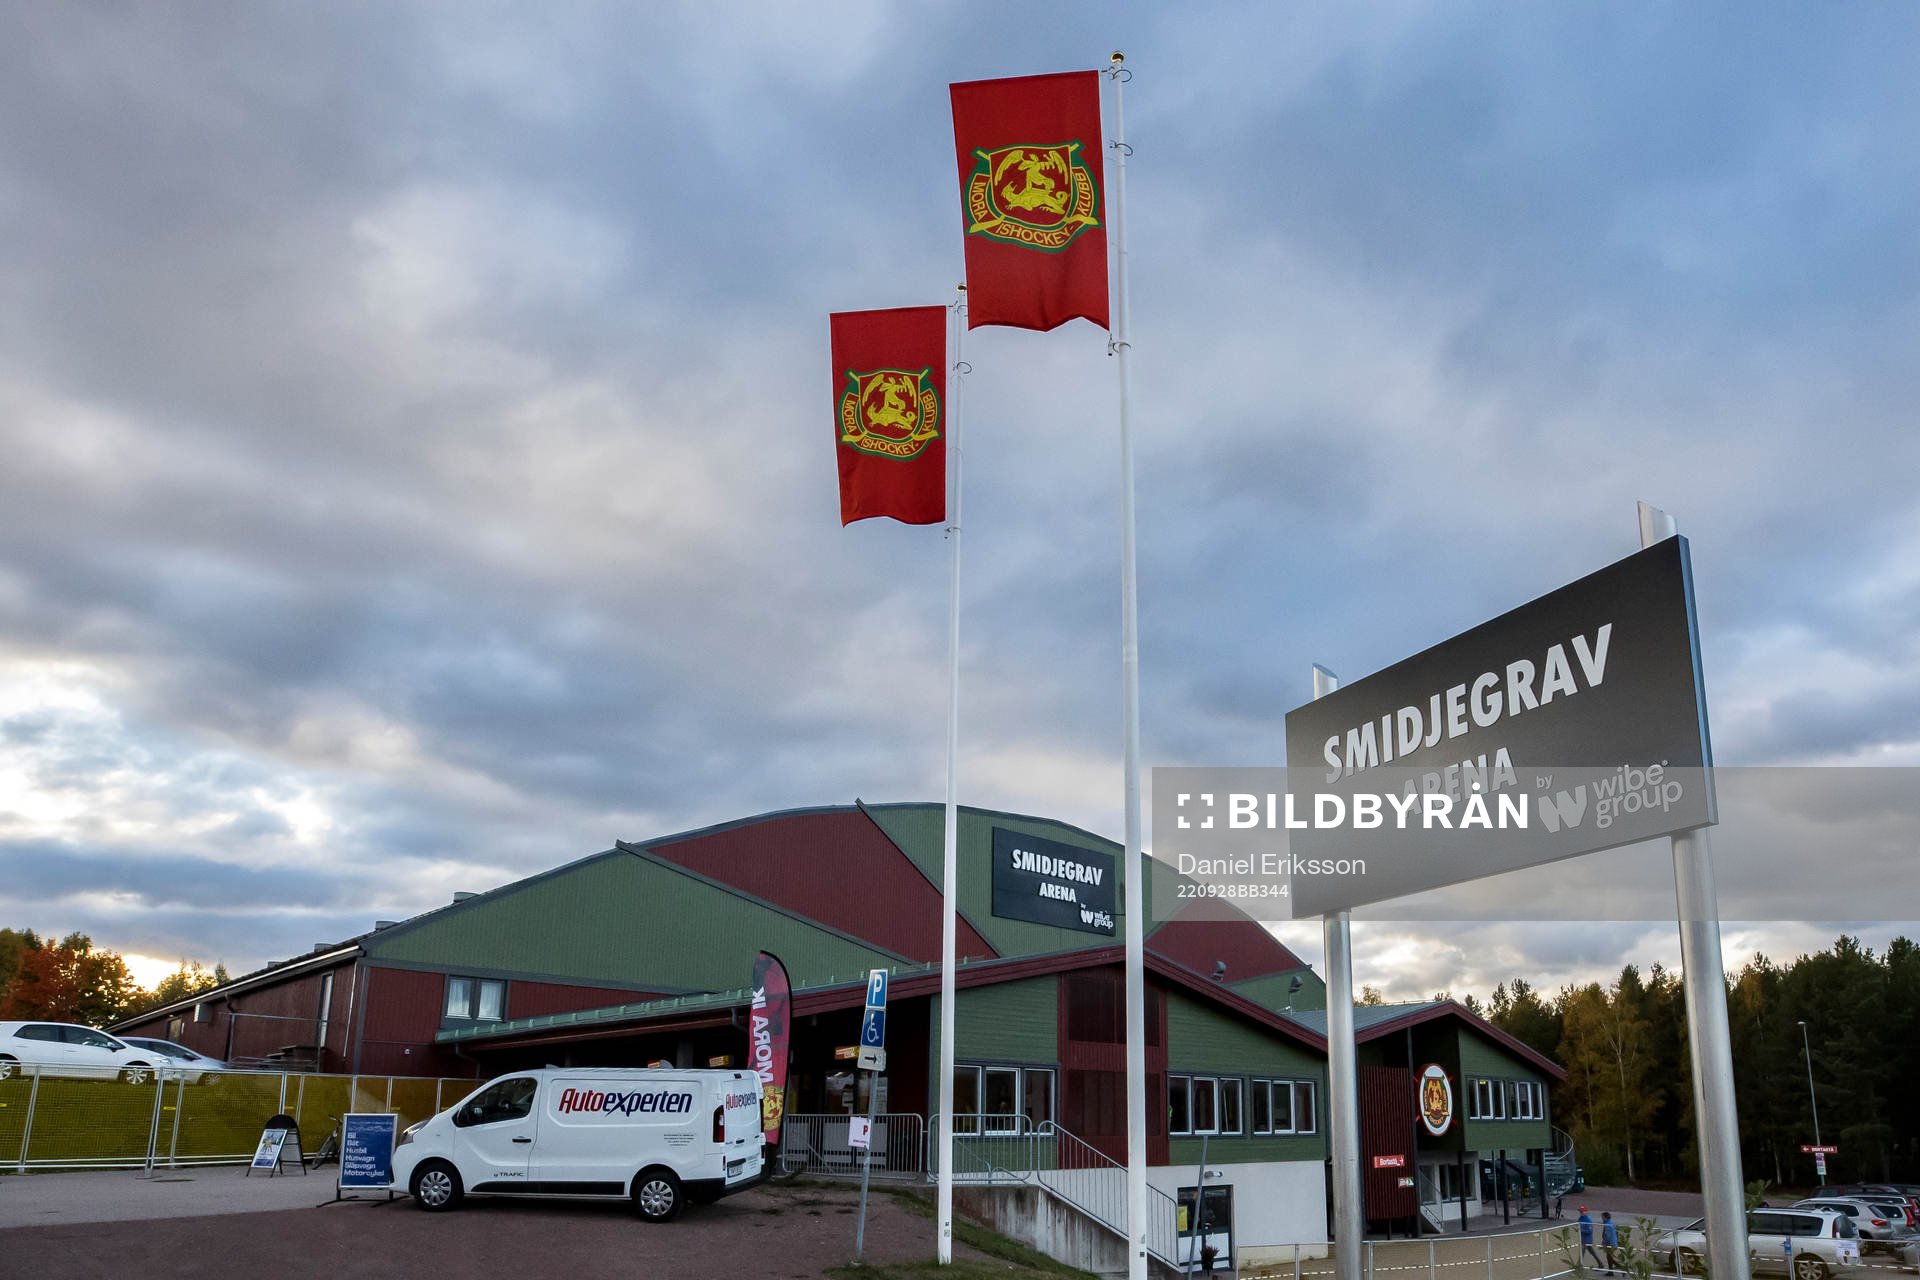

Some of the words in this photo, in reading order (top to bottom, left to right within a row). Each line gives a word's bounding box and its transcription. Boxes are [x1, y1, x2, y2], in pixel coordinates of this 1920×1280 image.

[971, 181, 989, 220] MORA
[1075, 172, 1092, 217] KLUBB
[843, 399, 858, 433] MORA
[922, 394, 936, 432] KLUBB
[1323, 622, 1613, 785] SMIDJEGRAV
[1401, 747, 1519, 817] ARENA
[1536, 775, 1553, 790] by
[1596, 781, 1684, 829] group
[1012, 849, 1103, 886] SMIDJEGRAV
[1039, 882, 1077, 903] ARENA
[872, 973, 883, 1004] P
[558, 1088, 693, 1117] Autoexperten
[343, 1169, 384, 1177] Motorcykel
